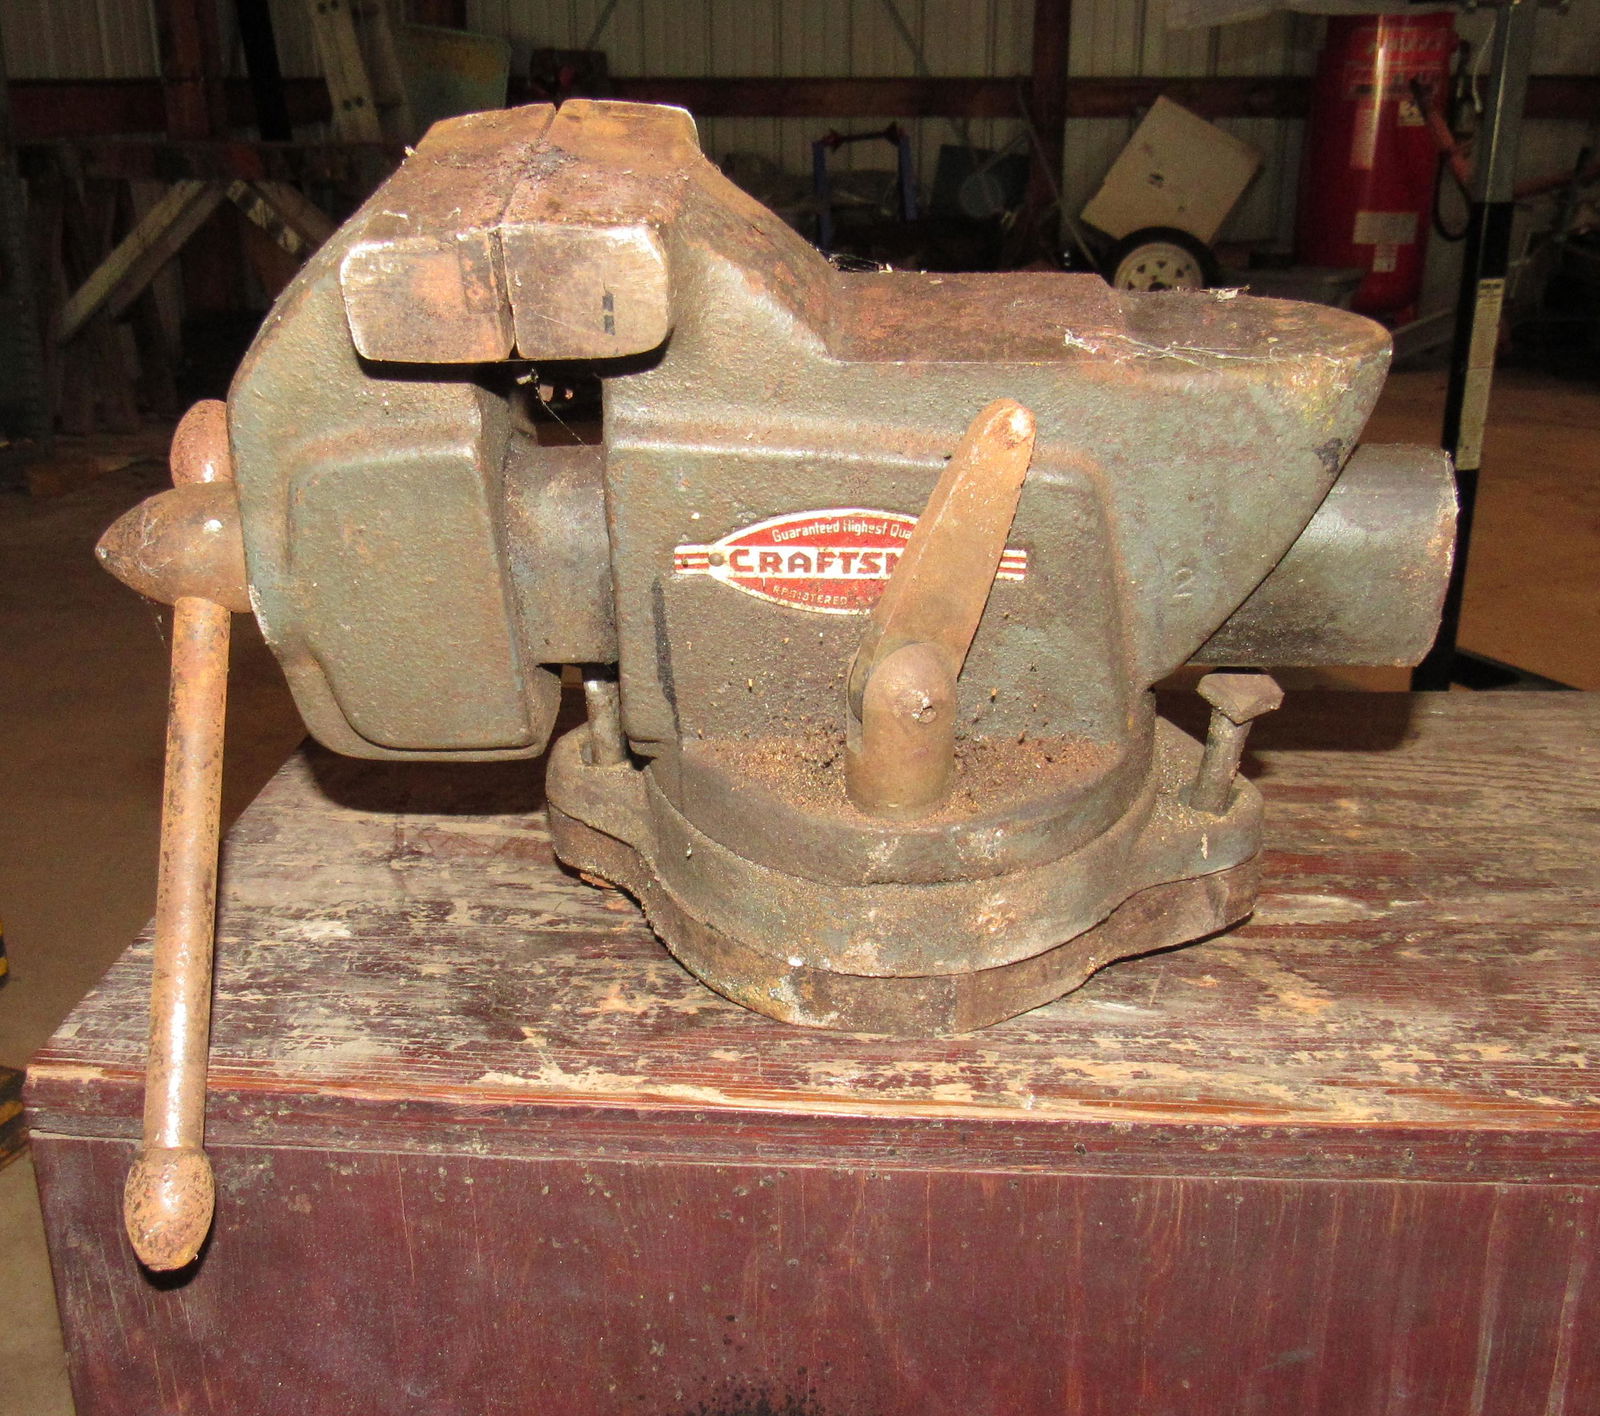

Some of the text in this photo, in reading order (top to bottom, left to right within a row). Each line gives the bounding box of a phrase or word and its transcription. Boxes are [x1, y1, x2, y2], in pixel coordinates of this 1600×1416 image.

[772, 519, 913, 543] Guaranteed Highest Qua
